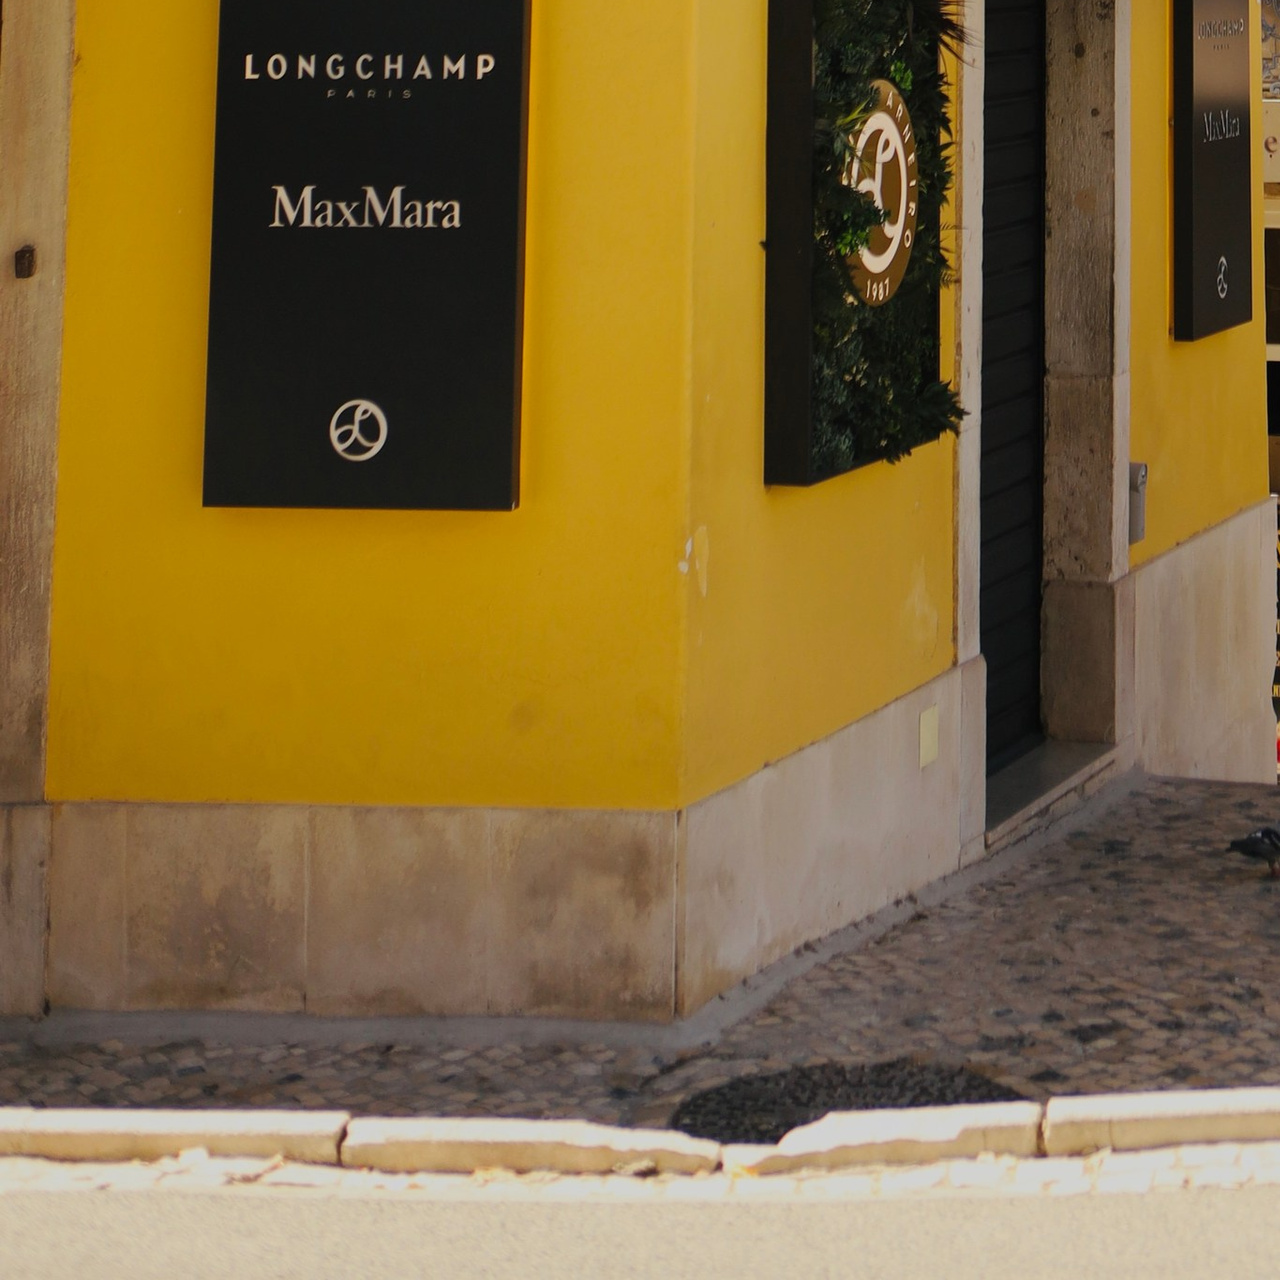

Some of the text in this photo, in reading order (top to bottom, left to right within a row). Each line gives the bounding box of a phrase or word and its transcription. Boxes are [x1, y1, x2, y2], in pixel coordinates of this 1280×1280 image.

[244, 53, 495, 80] LONGCHAMP
[326, 89, 412, 99] PARIS
[268, 185, 462, 229] MaxMara
